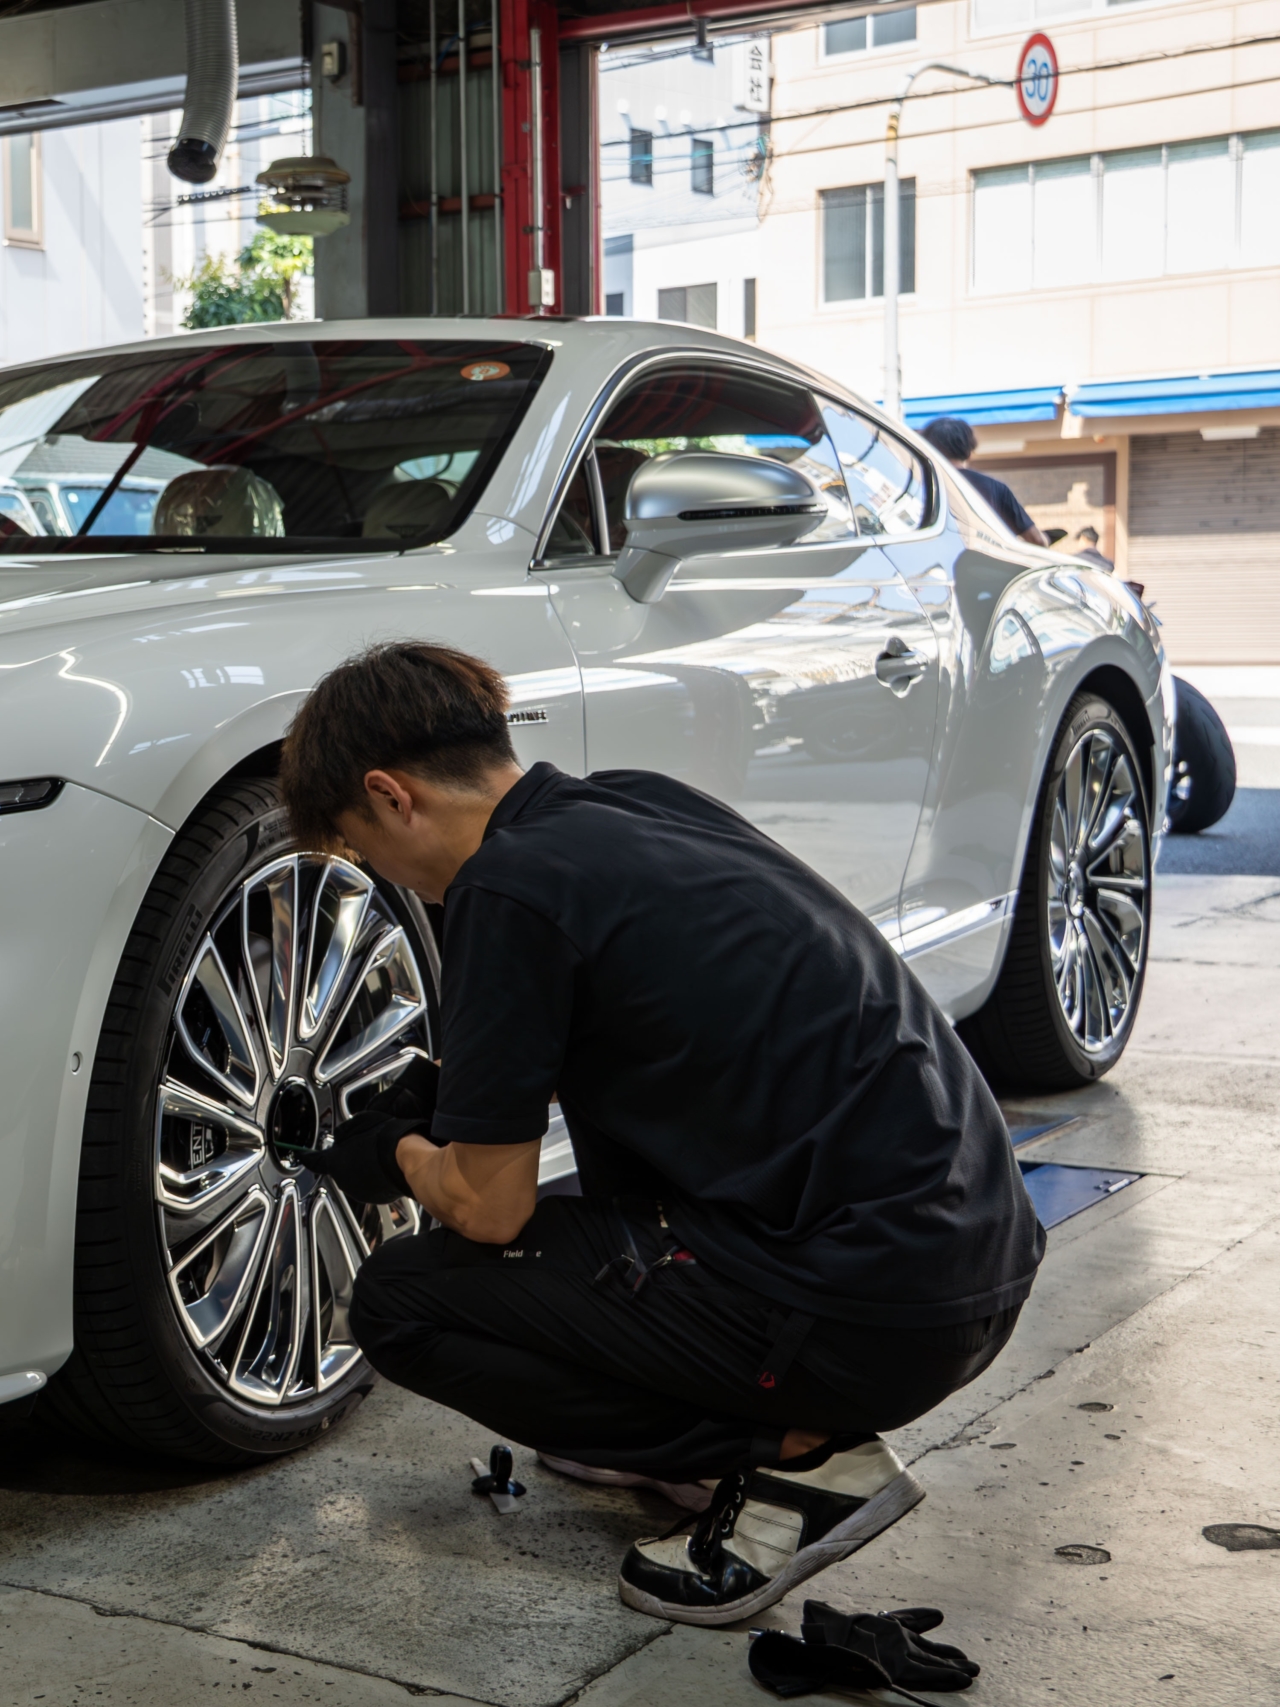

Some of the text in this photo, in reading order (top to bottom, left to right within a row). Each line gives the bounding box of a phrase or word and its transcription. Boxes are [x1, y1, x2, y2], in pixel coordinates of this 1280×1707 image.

[1024, 58, 1050, 102] 30
[157, 902, 203, 998] PIRELLI
[192, 1122, 203, 1165] ENT
